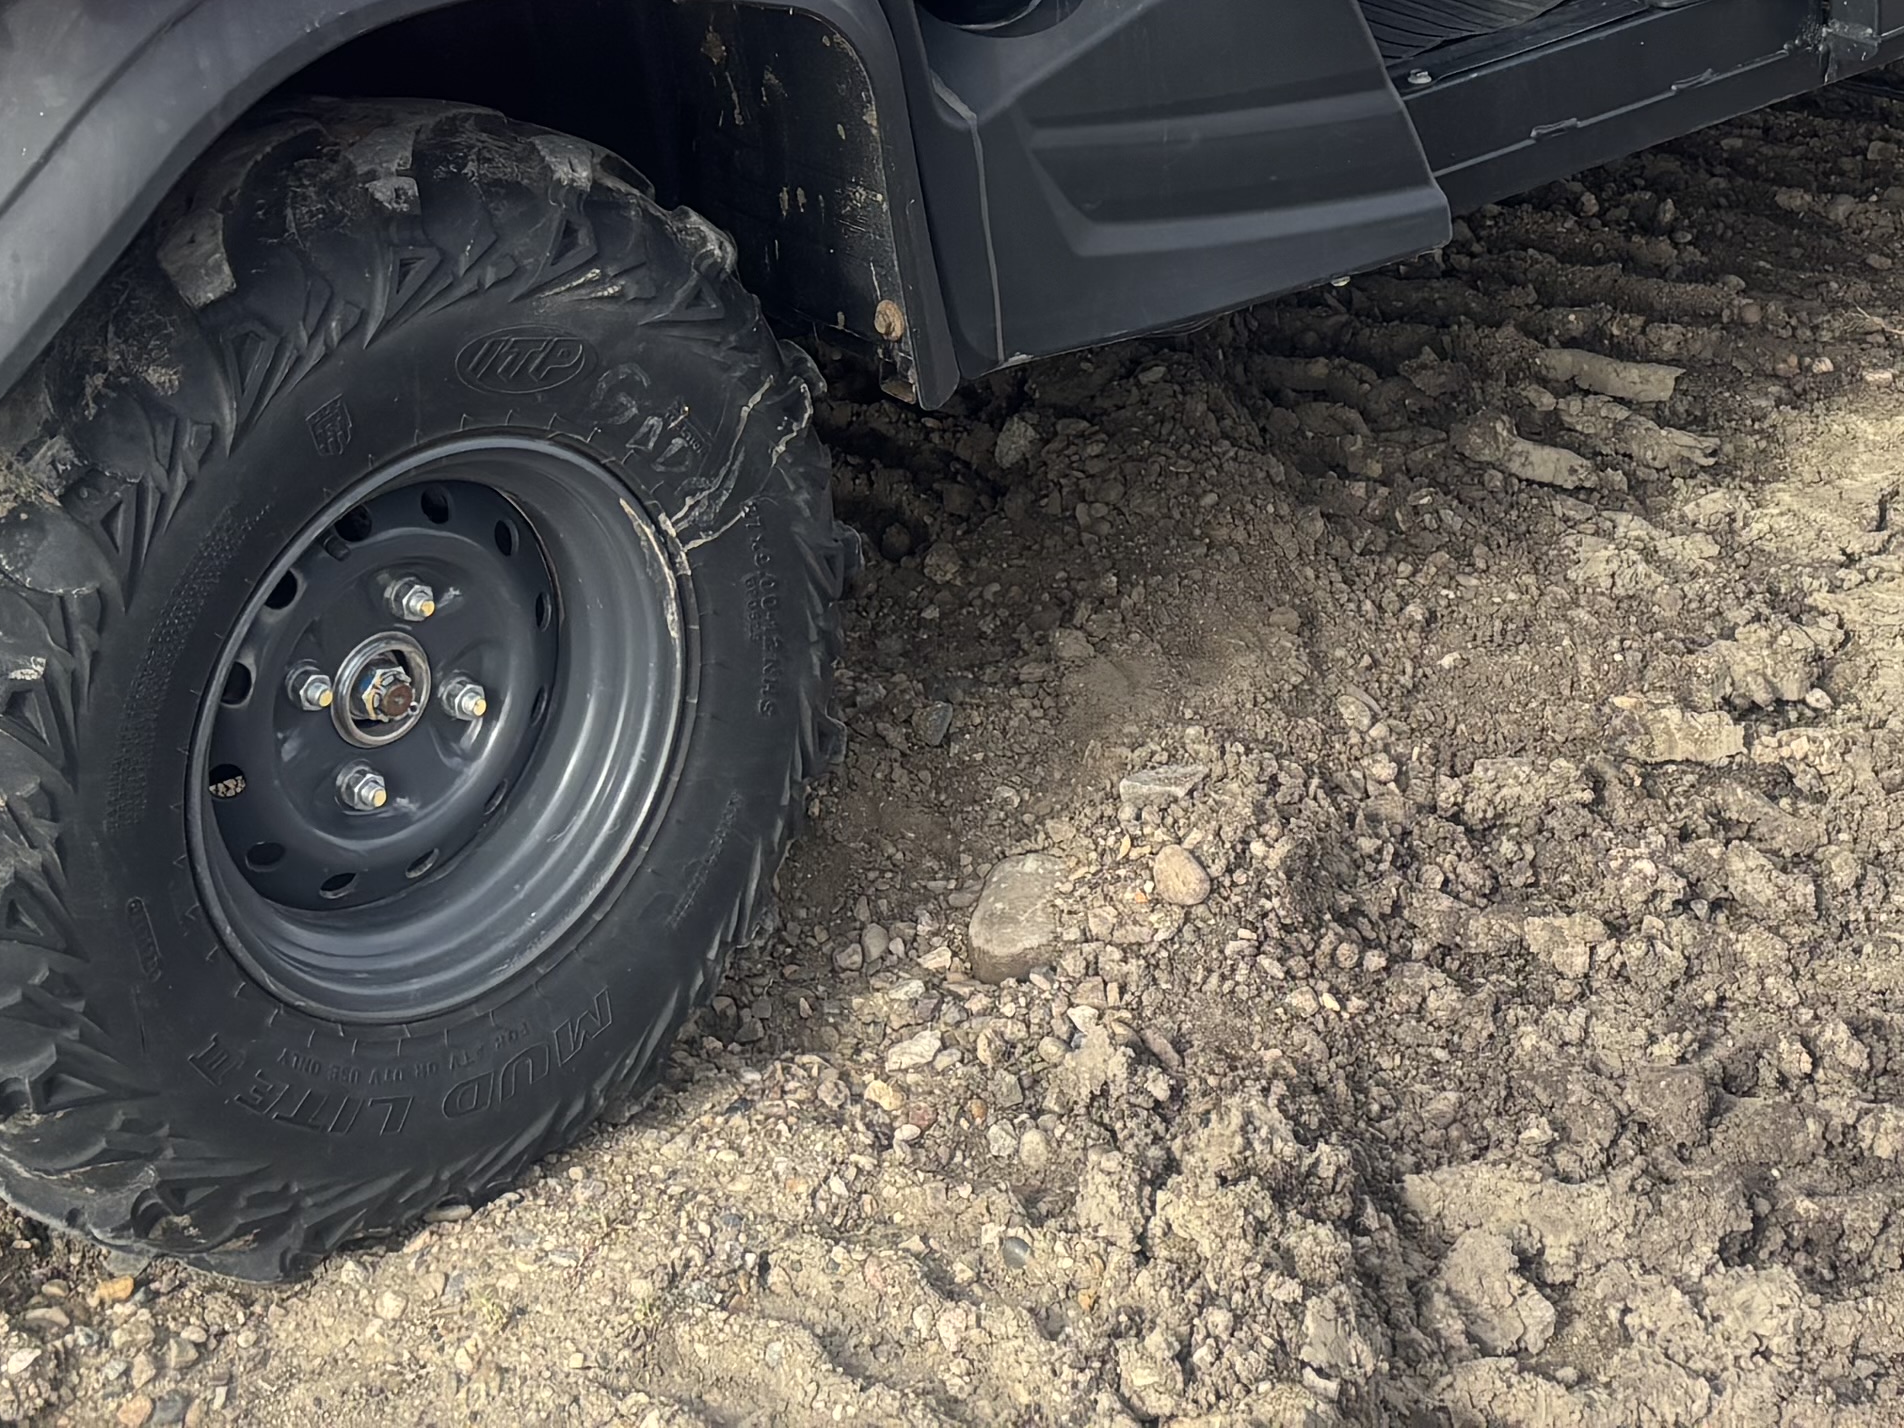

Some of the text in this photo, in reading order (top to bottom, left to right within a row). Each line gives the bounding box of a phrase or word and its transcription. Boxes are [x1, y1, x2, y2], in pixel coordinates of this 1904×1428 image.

[466, 336, 585, 383] ITP
[441, 985, 613, 1120] MUD
[233, 1070, 415, 1136] LITE
